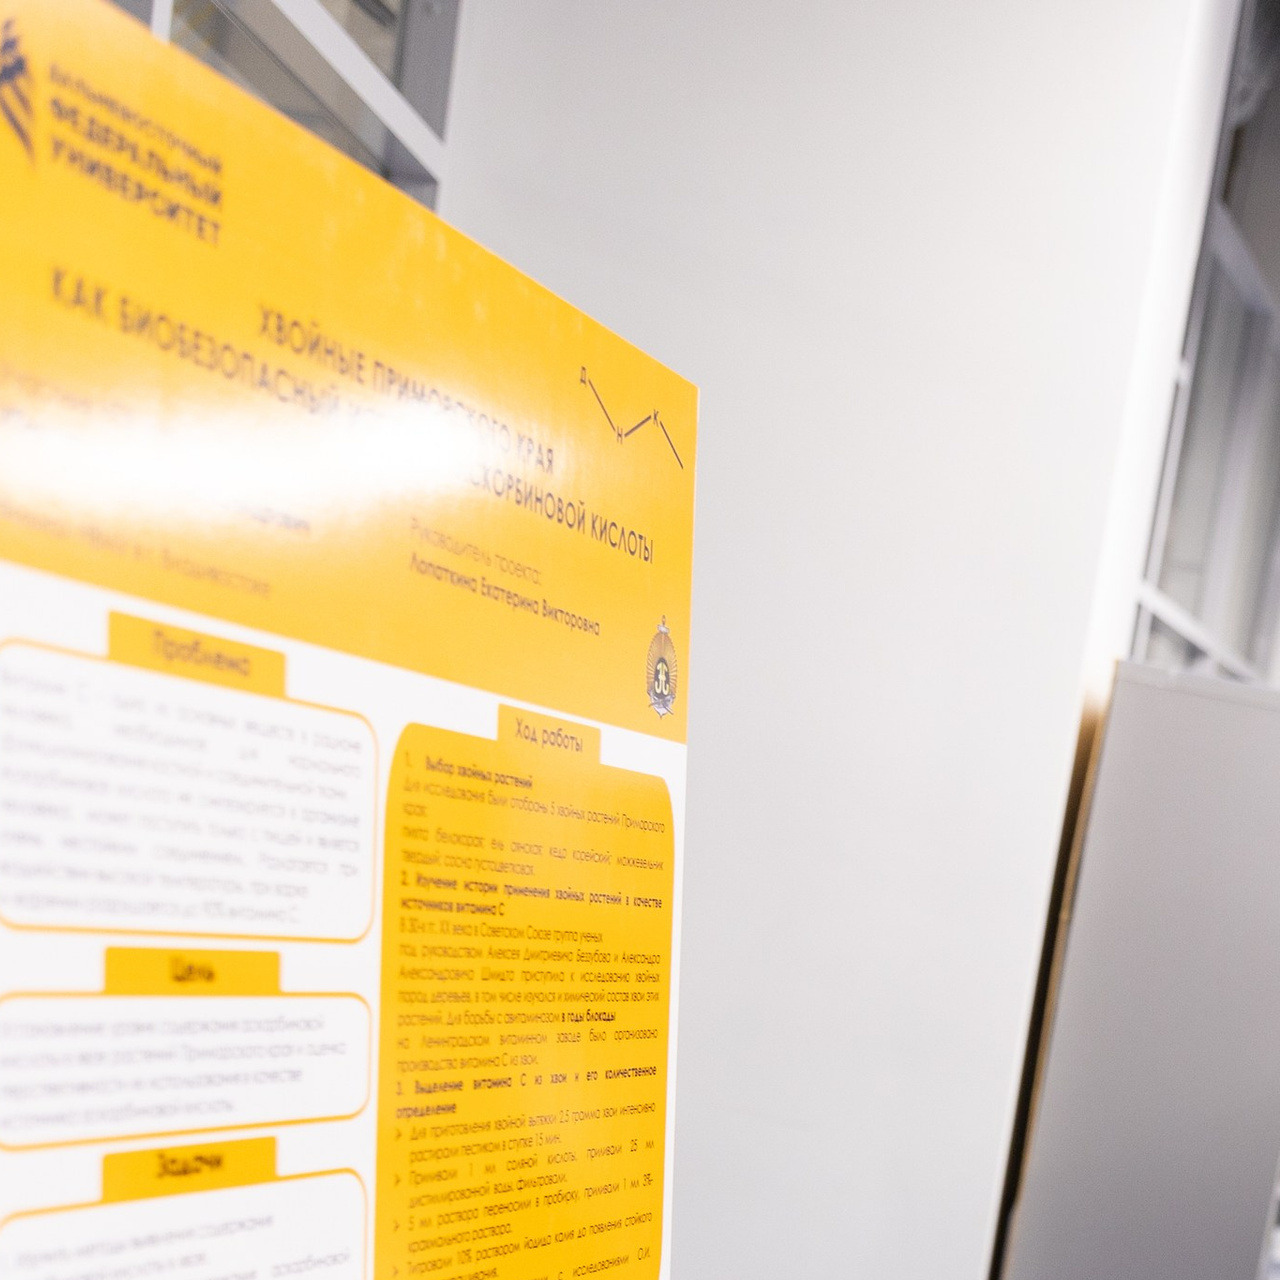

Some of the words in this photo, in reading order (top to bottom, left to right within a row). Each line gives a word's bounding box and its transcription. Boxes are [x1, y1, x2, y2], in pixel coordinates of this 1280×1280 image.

[51, 97, 222, 207] ФЕДЕРАЛЬНЫЙ
[51, 136, 221, 245] УНИВЕРСИТЕТ
[53, 266, 108, 321] КАК
[120, 296, 340, 416] БИОБЕЗОПАСНЫЙ
[259, 304, 366, 386] ХВОЙНЫЕ
[517, 432, 554, 473] КРАЯ
[615, 425, 624, 446] Н
[652, 408, 661, 427] К
[466, 462, 586, 536] СКОРБИНОВОЙ
[590, 512, 654, 564] КИСЛОТЫ
[410, 551, 478, 593] Лопаткина
[481, 575, 540, 616] Екатерина
[542, 598, 600, 637] Викторовна
[153, 628, 250, 676] Проблема
[515, 717, 538, 744] Ход
[541, 726, 584, 754] работы
[621, 813, 665, 836] Приморского
[555, 884, 584, 903] хвойных
[589, 887, 621, 907] растений
[633, 894, 662, 909] качестве
[635, 969, 660, 984] хвойных
[567, 1008, 584, 1025] годы
[585, 1006, 616, 1024] блокады
[614, 1025, 658, 1043] организовано
[473, 1073, 512, 1092] витамина
[550, 1070, 567, 1085] хвои
[586, 1068, 597, 1083] его
[605, 1063, 656, 1081] количественное
[619, 1099, 655, 1118] интенсивно
[586, 1140, 622, 1162] приливали
[630, 1137, 637, 1153] 25
[155, 1151, 225, 1179] Задачи
[624, 1206, 652, 1230] стойкого
[637, 1244, 650, 1262] О.И.
